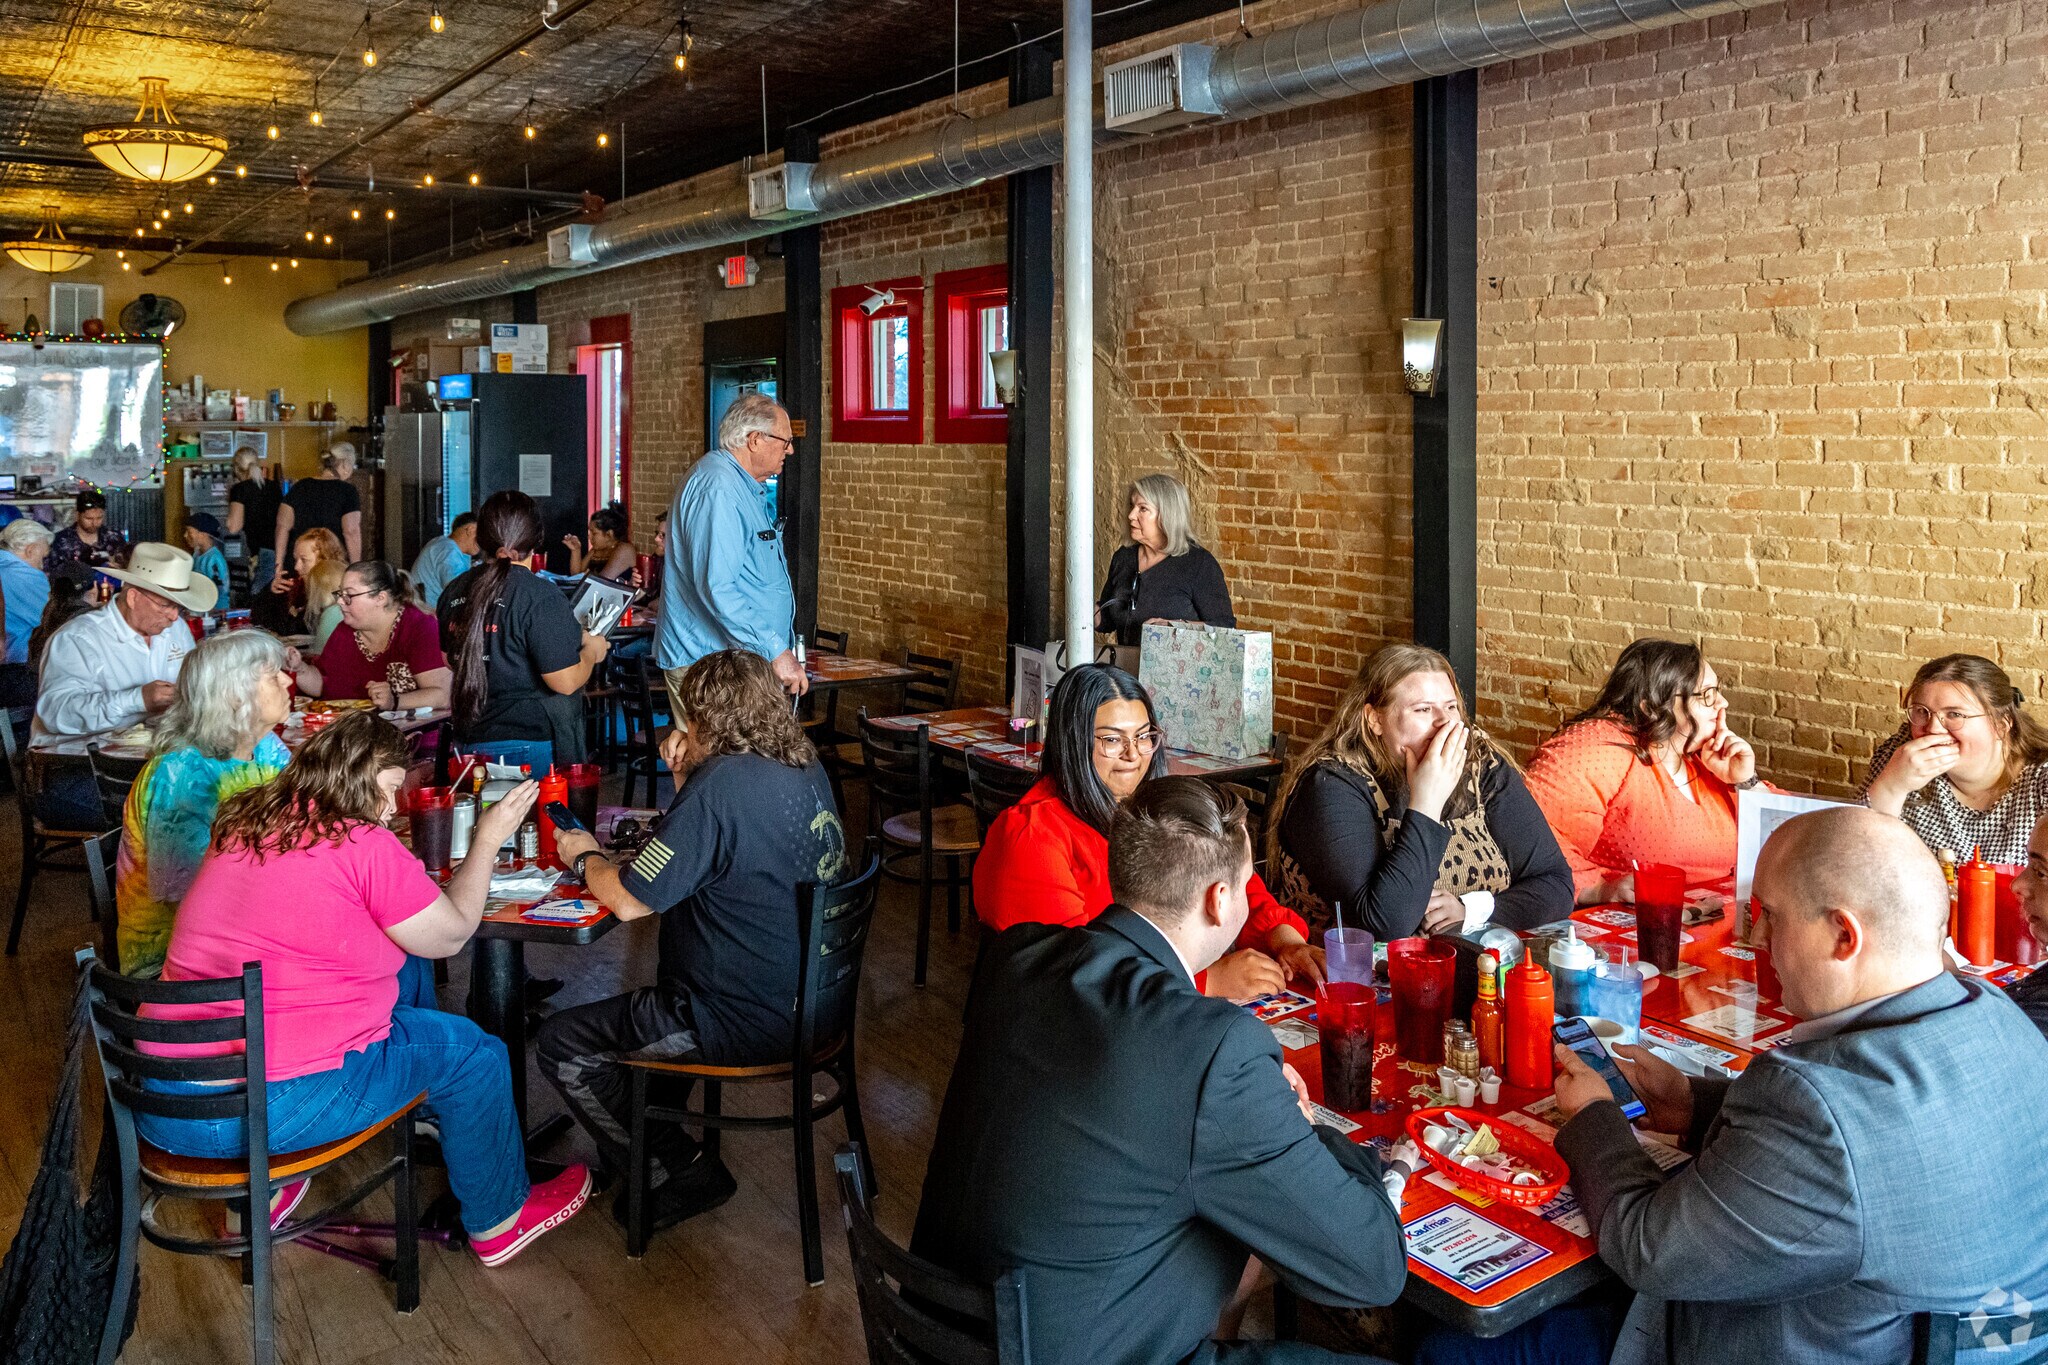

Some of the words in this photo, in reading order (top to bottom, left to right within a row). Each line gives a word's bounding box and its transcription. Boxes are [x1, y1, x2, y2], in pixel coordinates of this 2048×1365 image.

[728, 256, 745, 286] EXIT
[544, 1193, 585, 1229] crocs
[1405, 1216, 1453, 1241] Kaufman
